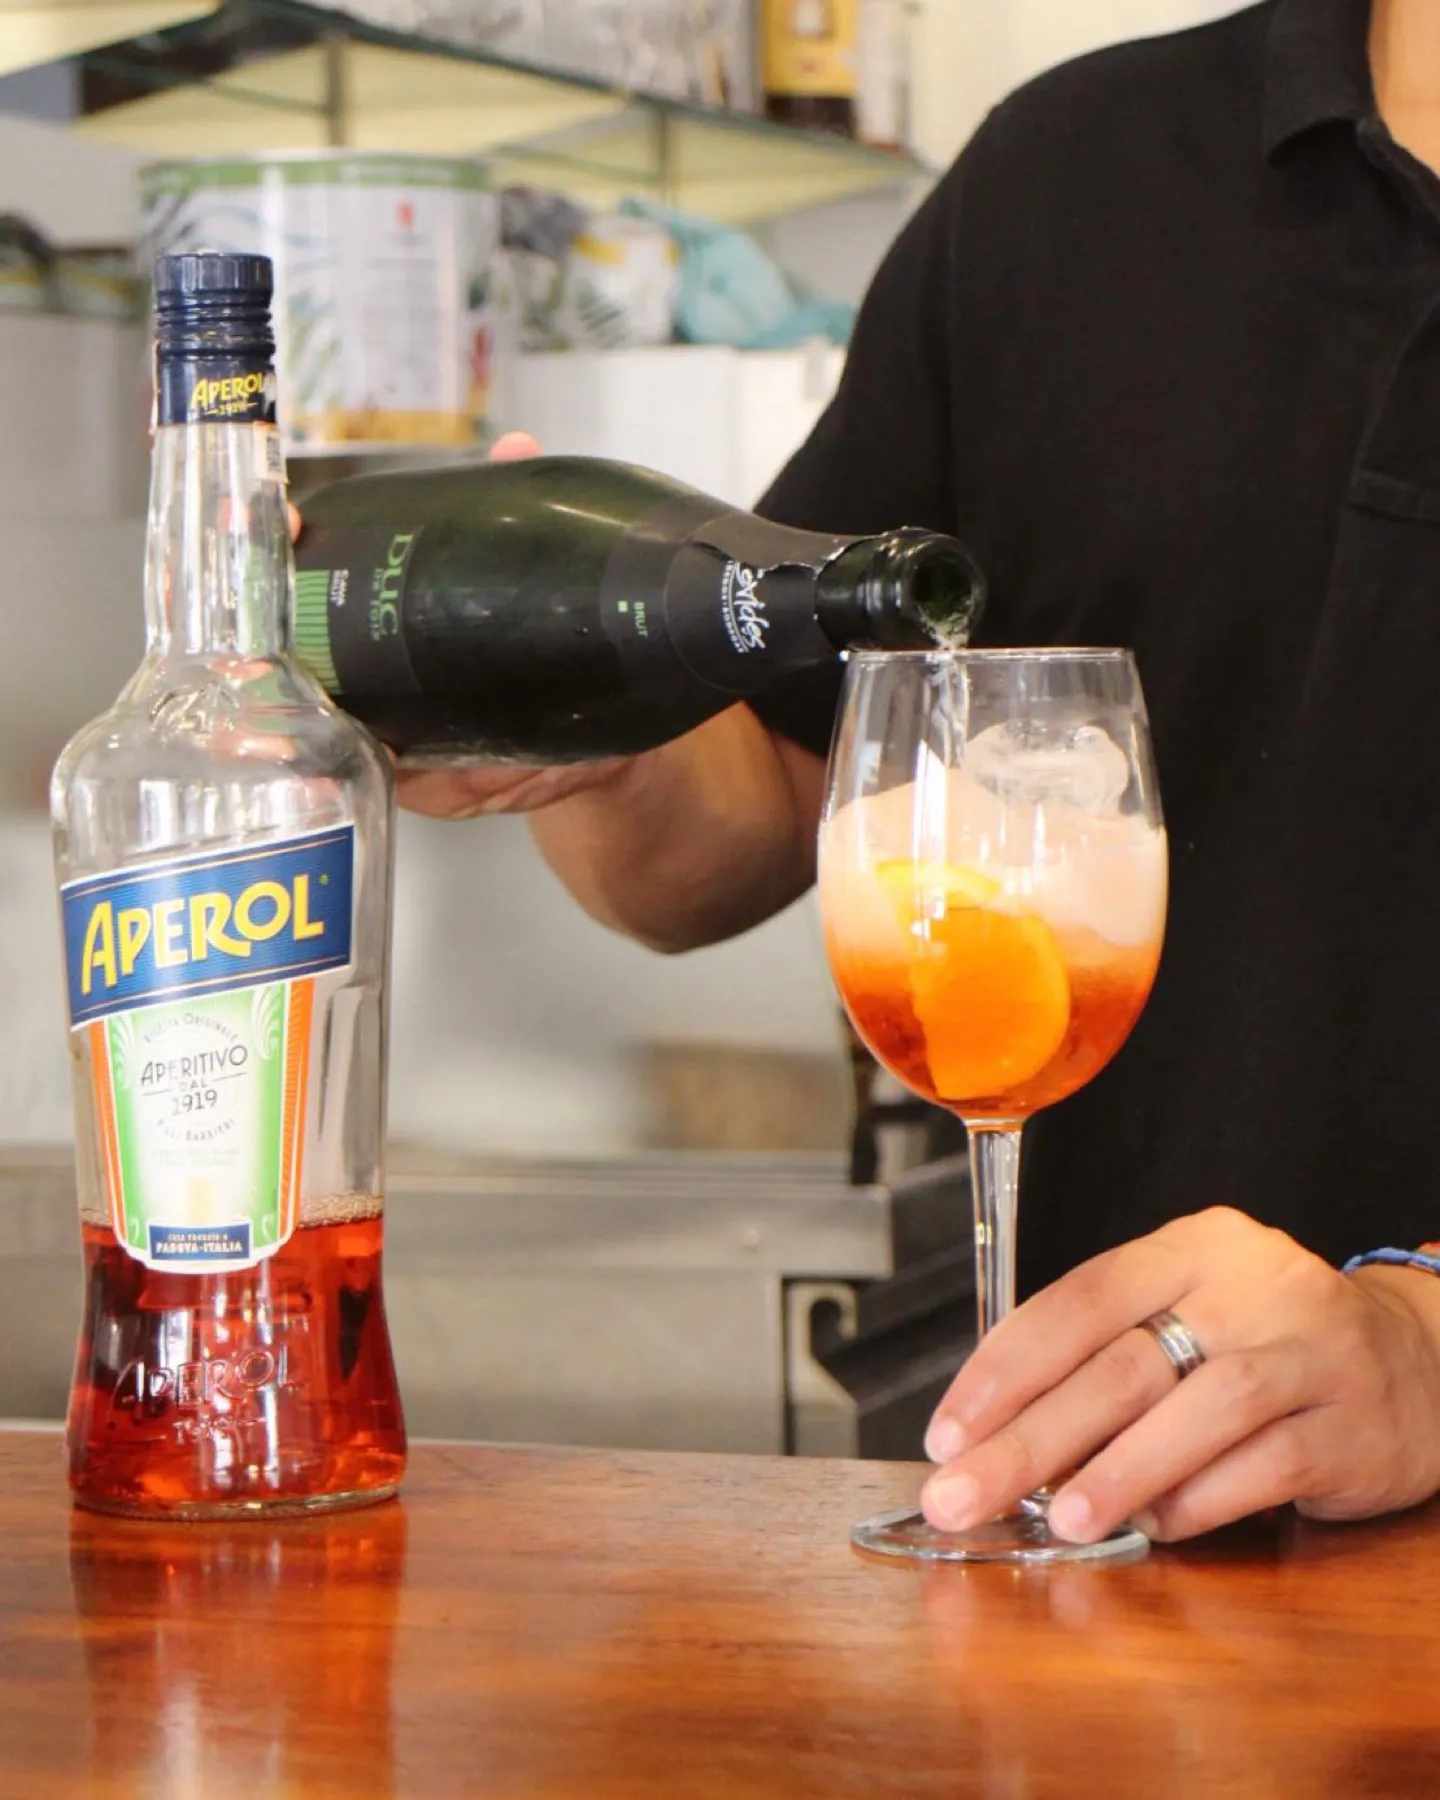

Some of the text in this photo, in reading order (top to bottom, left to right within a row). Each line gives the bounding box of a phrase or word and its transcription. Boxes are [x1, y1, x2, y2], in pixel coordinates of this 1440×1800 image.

[190, 372, 266, 410] APEROL
[379, 532, 414, 635] DUC
[634, 602, 649, 637] BRUT
[81, 874, 325, 995] APEROL
[183, 1012, 240, 1043] ORIGINALE
[140, 1044, 249, 1087] APERITIVO
[172, 1089, 218, 1116] 1919
[178, 1078, 209, 1092] DAL
[106, 1347, 298, 1429] APEROL
